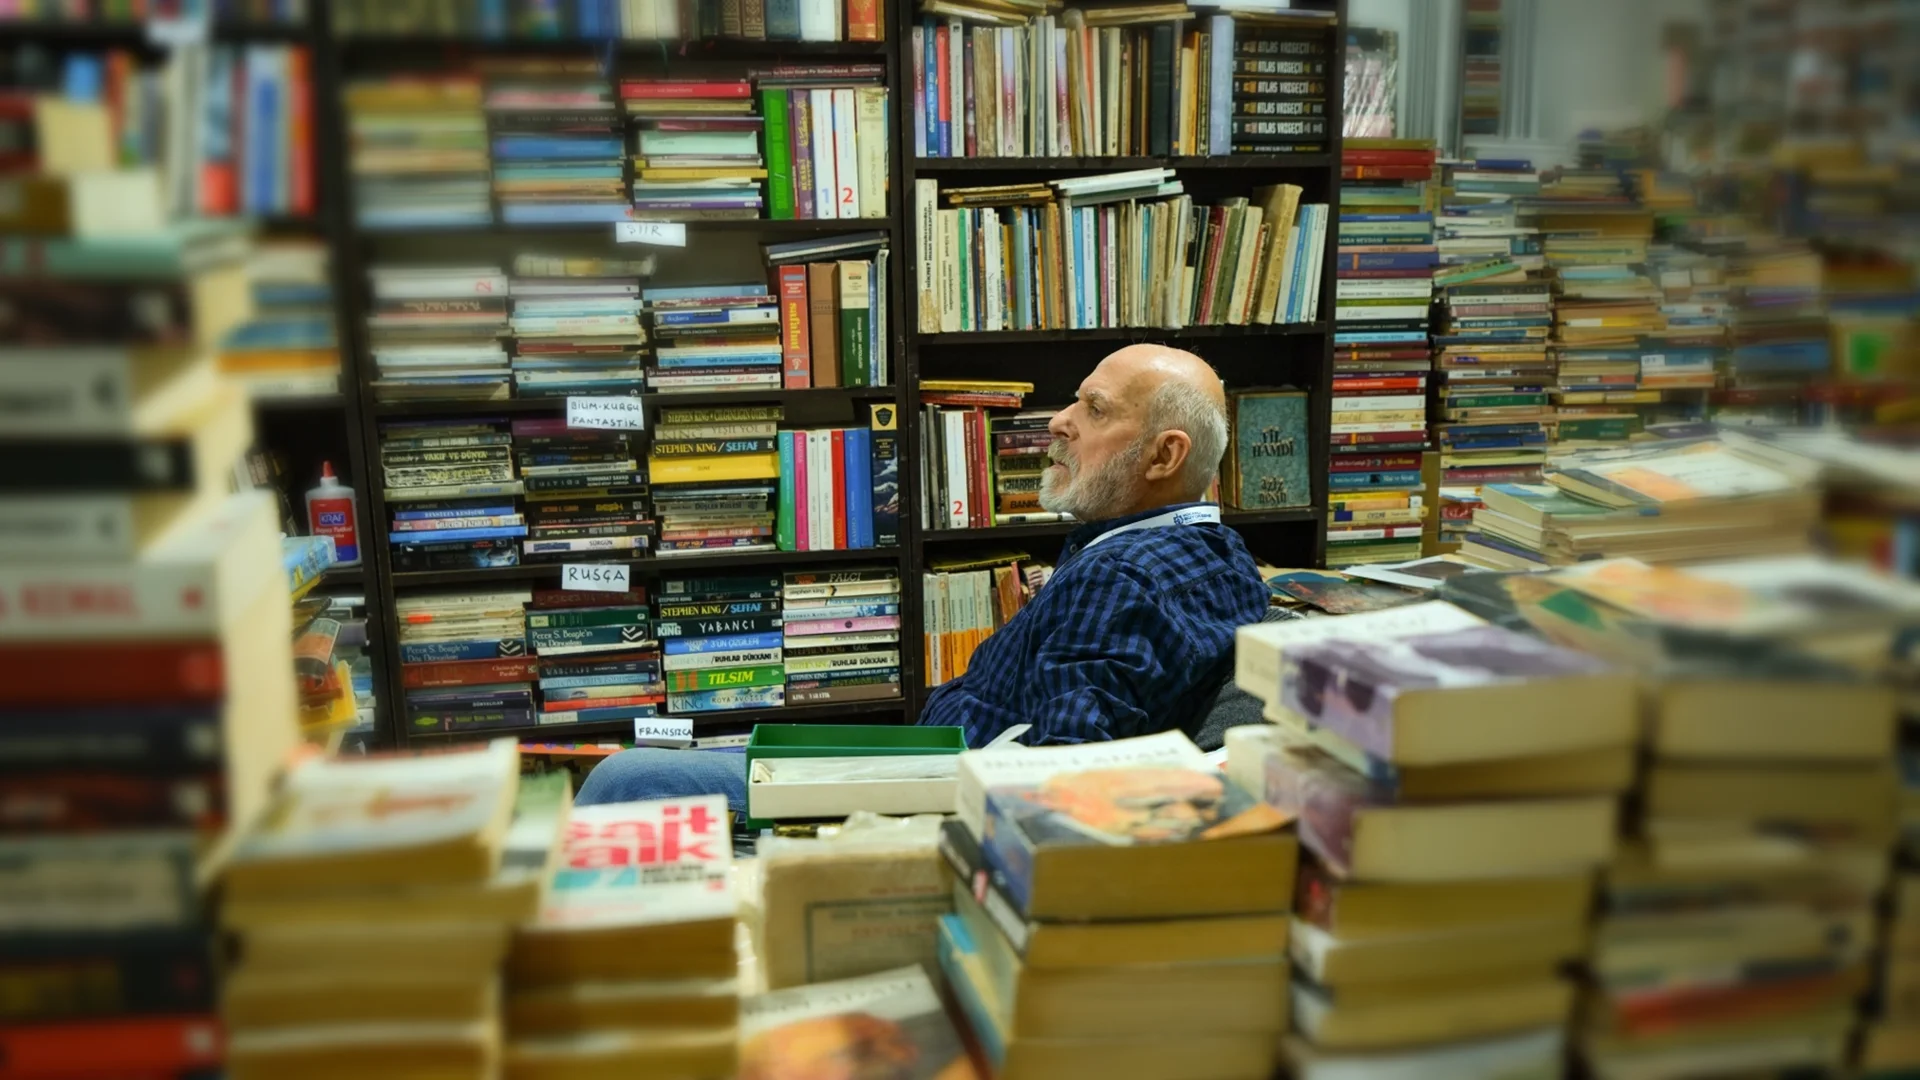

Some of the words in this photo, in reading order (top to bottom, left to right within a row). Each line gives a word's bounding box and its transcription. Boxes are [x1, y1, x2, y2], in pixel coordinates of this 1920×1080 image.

[821, 188, 829, 204] 1
[842, 188, 854, 203] 2
[788, 302, 801, 350] safahat
[571, 416, 638, 429] FANTASTİK
[694, 410, 709, 422] KING
[655, 442, 694, 455] STEPHEN
[696, 441, 717, 453] KING
[952, 501, 963, 515] 2
[589, 539, 613, 547] SÜRGÜN
[568, 566, 626, 584] RUSÇA
[829, 572, 861, 583] FALCI
[661, 606, 699, 617] STEPHEN
[701, 604, 721, 615] KING
[657, 626, 681, 636] KING
[699, 620, 755, 634] YABANCI
[708, 671, 755, 685] TILSIM
[672, 698, 704, 711] KING
